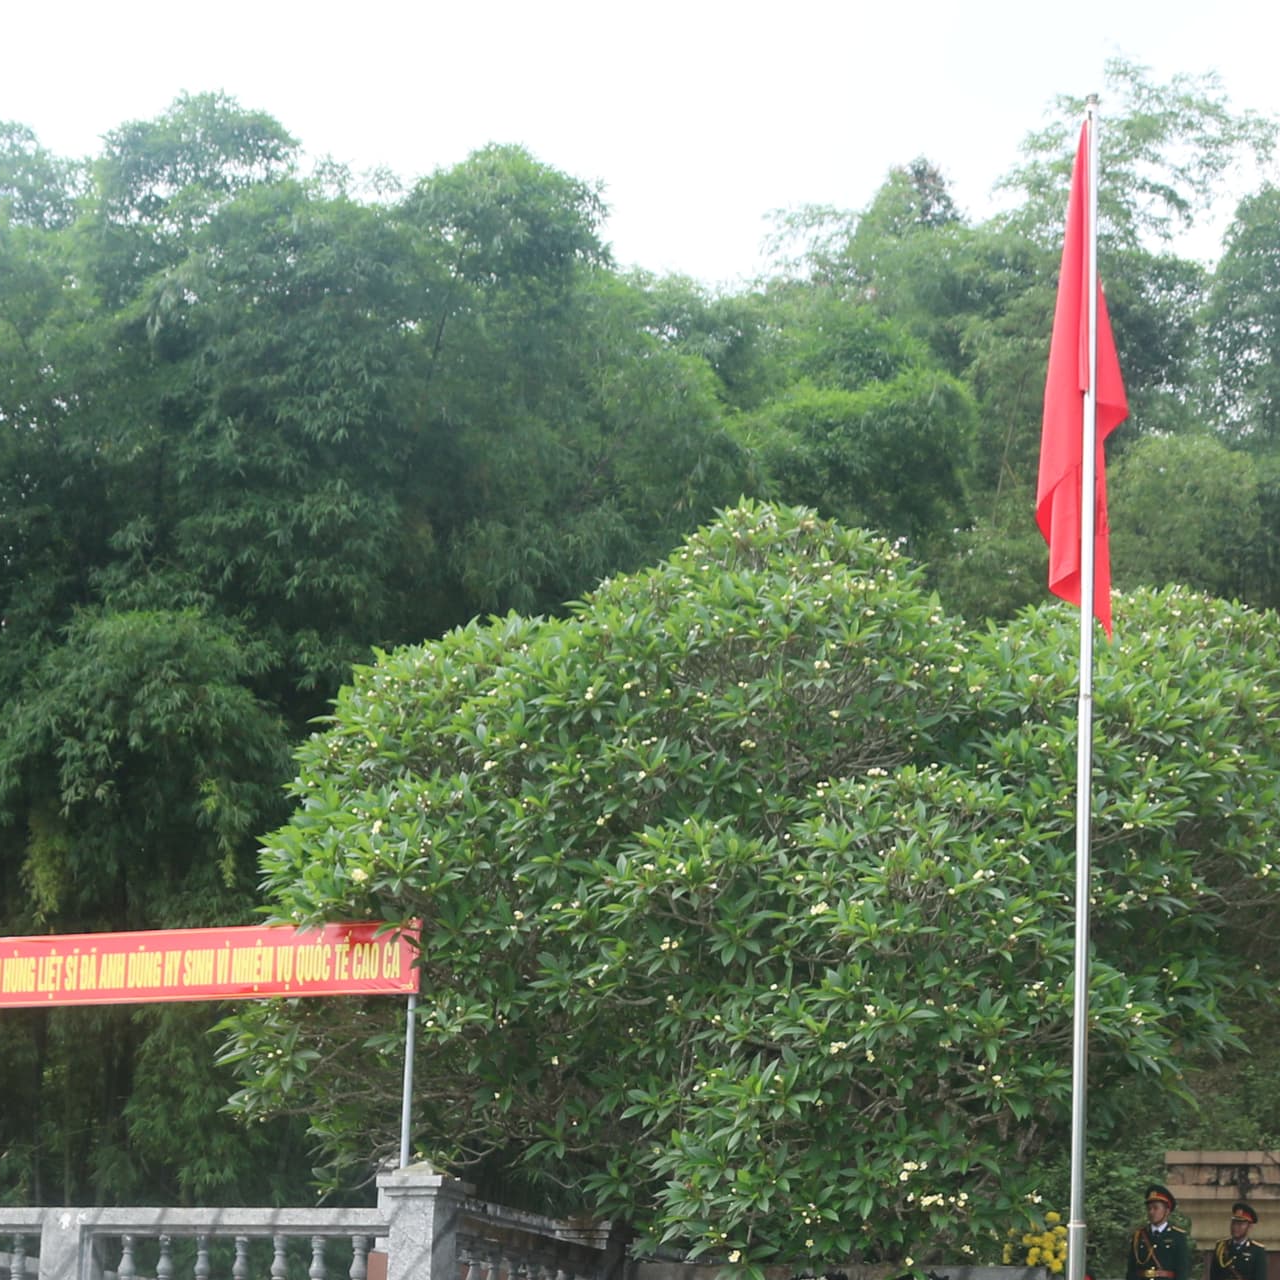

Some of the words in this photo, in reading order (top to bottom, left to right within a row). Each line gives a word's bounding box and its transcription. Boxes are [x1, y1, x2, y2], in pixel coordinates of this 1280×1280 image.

[2, 949, 36, 993] HÙNG
[37, 948, 63, 999] LIỆT
[64, 948, 80, 991] SĨ
[79, 947, 97, 990] ĐÃ
[98, 953, 126, 989] ANH
[126, 945, 162, 989] DŨNG
[163, 951, 182, 987] HY
[183, 949, 215, 986] SINH
[216, 940, 230, 985] VÌ
[231, 939, 274, 991] NHIỆM
[276, 945, 294, 991] VỤ
[295, 931, 331, 986] QUỐC
[334, 930, 353, 981] TẾ
[352, 942, 380, 980] CAO
